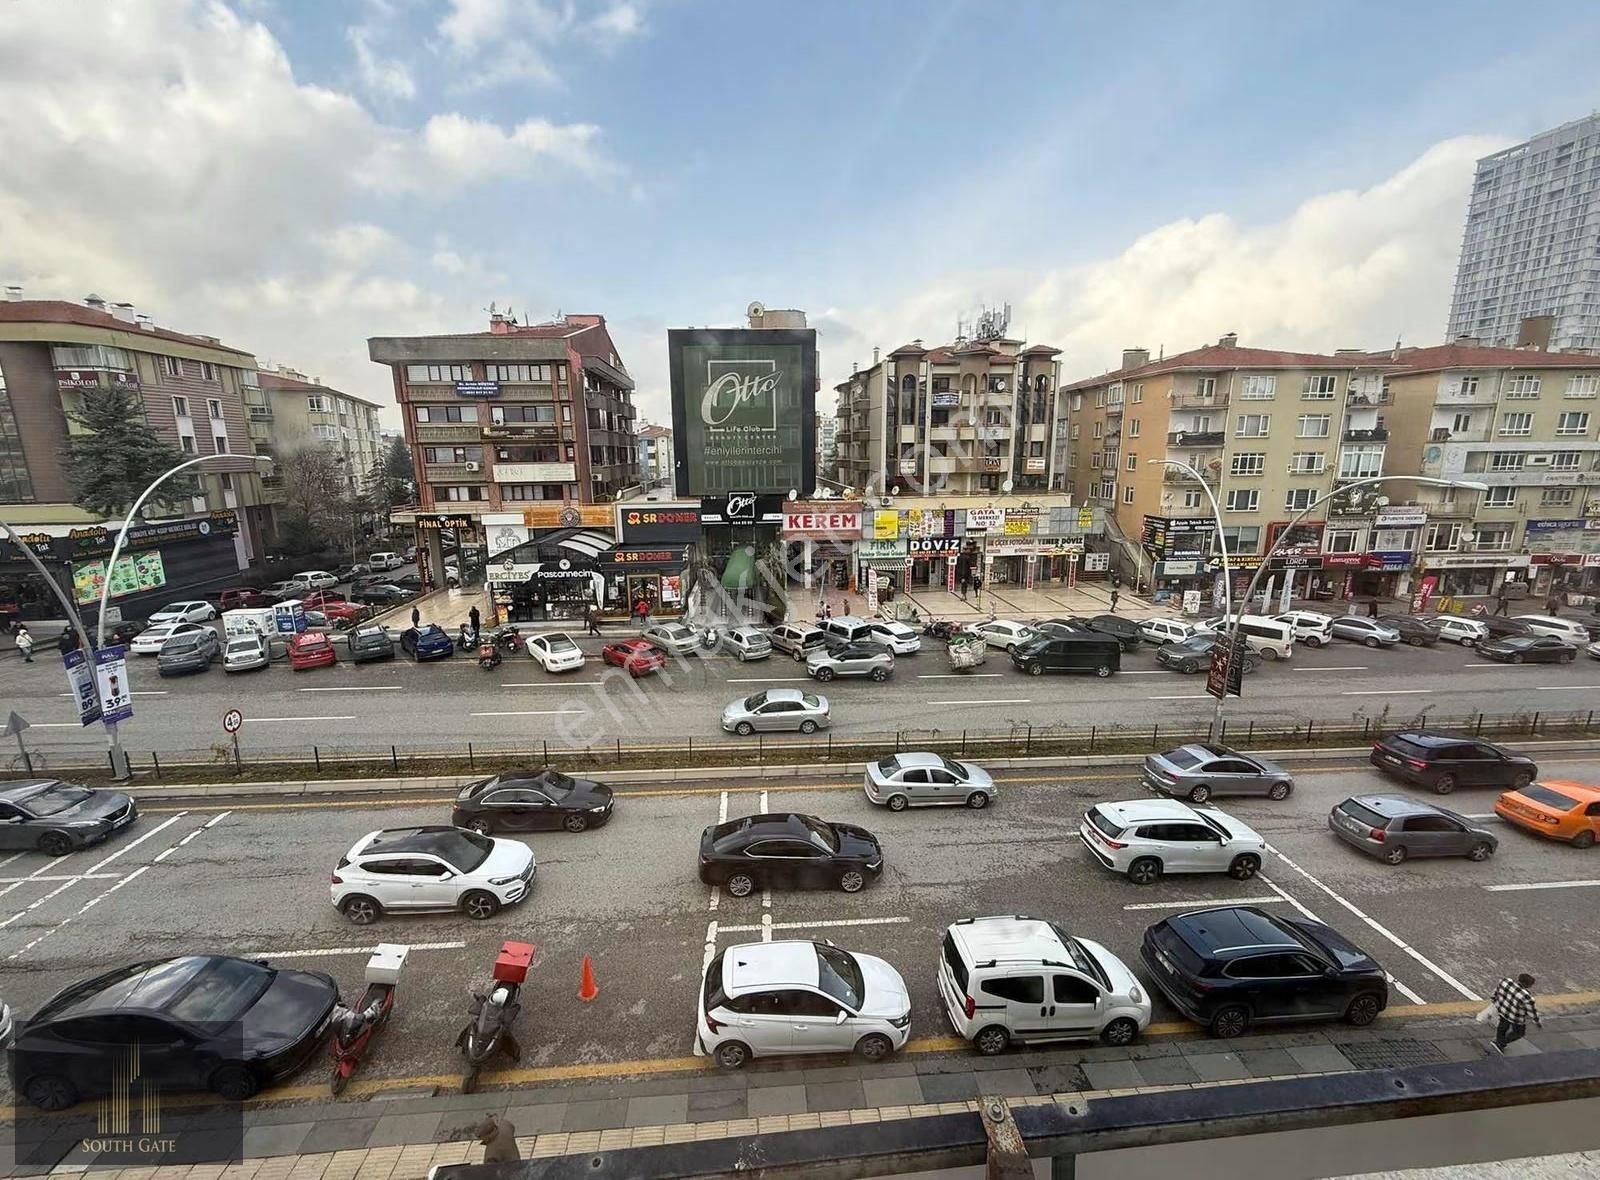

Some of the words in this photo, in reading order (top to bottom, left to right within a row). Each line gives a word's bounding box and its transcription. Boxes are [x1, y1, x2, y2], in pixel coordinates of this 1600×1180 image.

[701, 370, 783, 425] Otto
[727, 496, 757, 516] Otto
[420, 519, 442, 528] FİNAL
[445, 518, 468, 527] OPTİK
[643, 514, 657, 523] SR
[788, 514, 857, 529] KEREM
[70, 527, 107, 539] Anadolu
[36, 543, 49, 551] Tat
[489, 571, 530, 580] ERCİYES
[81, 698, 94, 710] 89
[105, 696, 121, 709] 39
